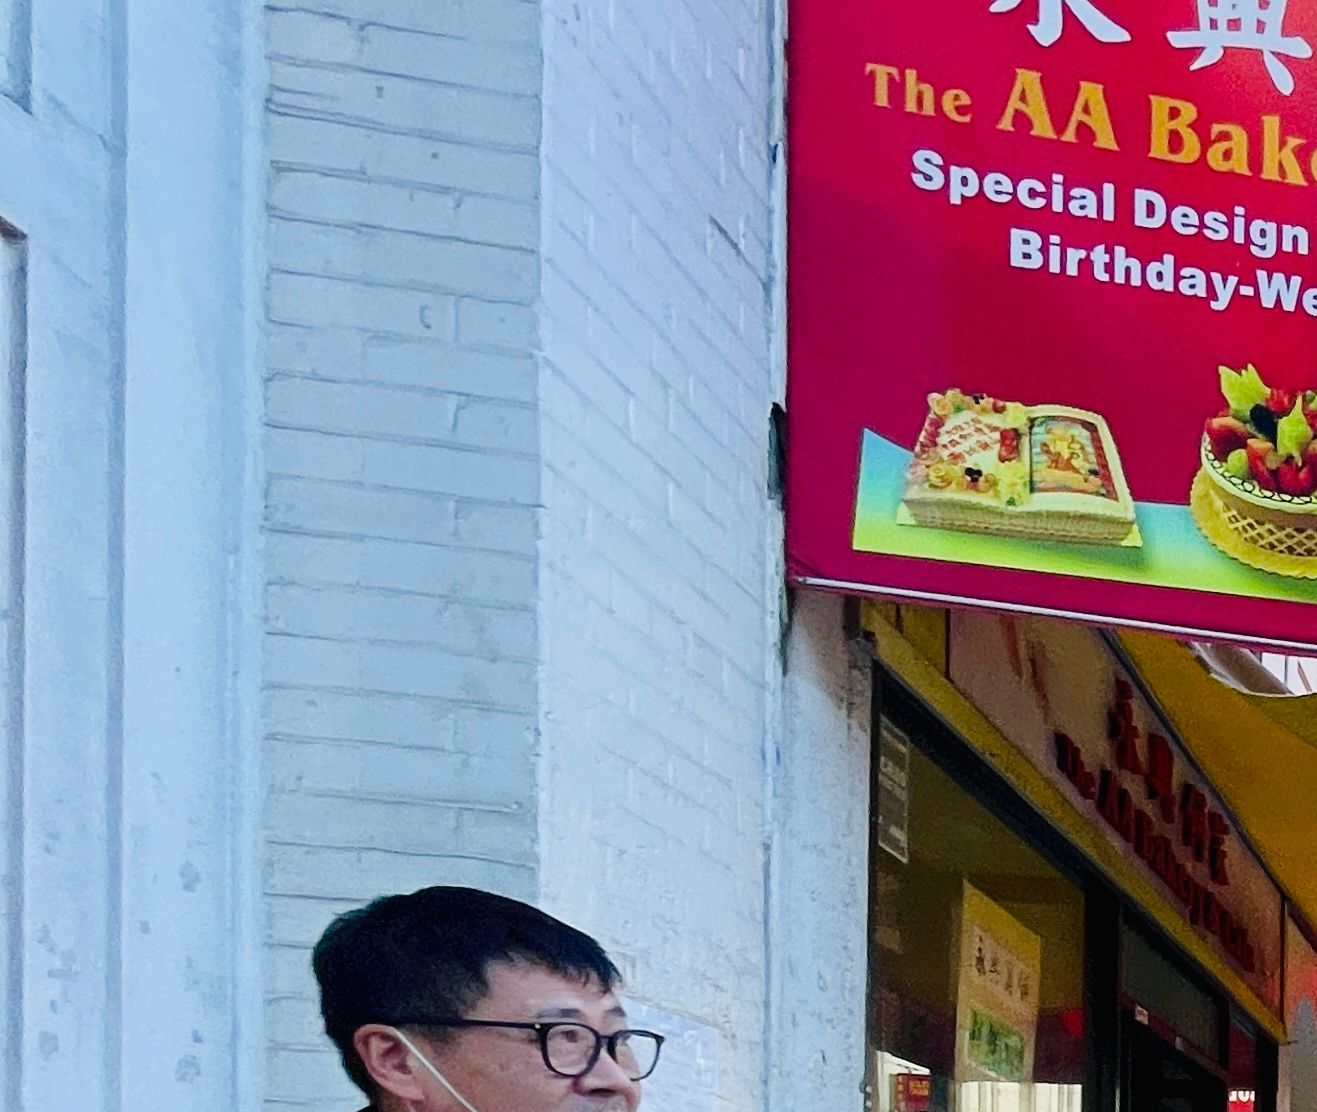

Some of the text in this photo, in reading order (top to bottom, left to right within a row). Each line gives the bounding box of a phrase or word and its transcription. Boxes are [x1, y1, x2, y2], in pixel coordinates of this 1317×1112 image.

[864, 62, 972, 124] The
[911, 148, 1116, 223] Special
[1133, 187, 1311, 259] Design
